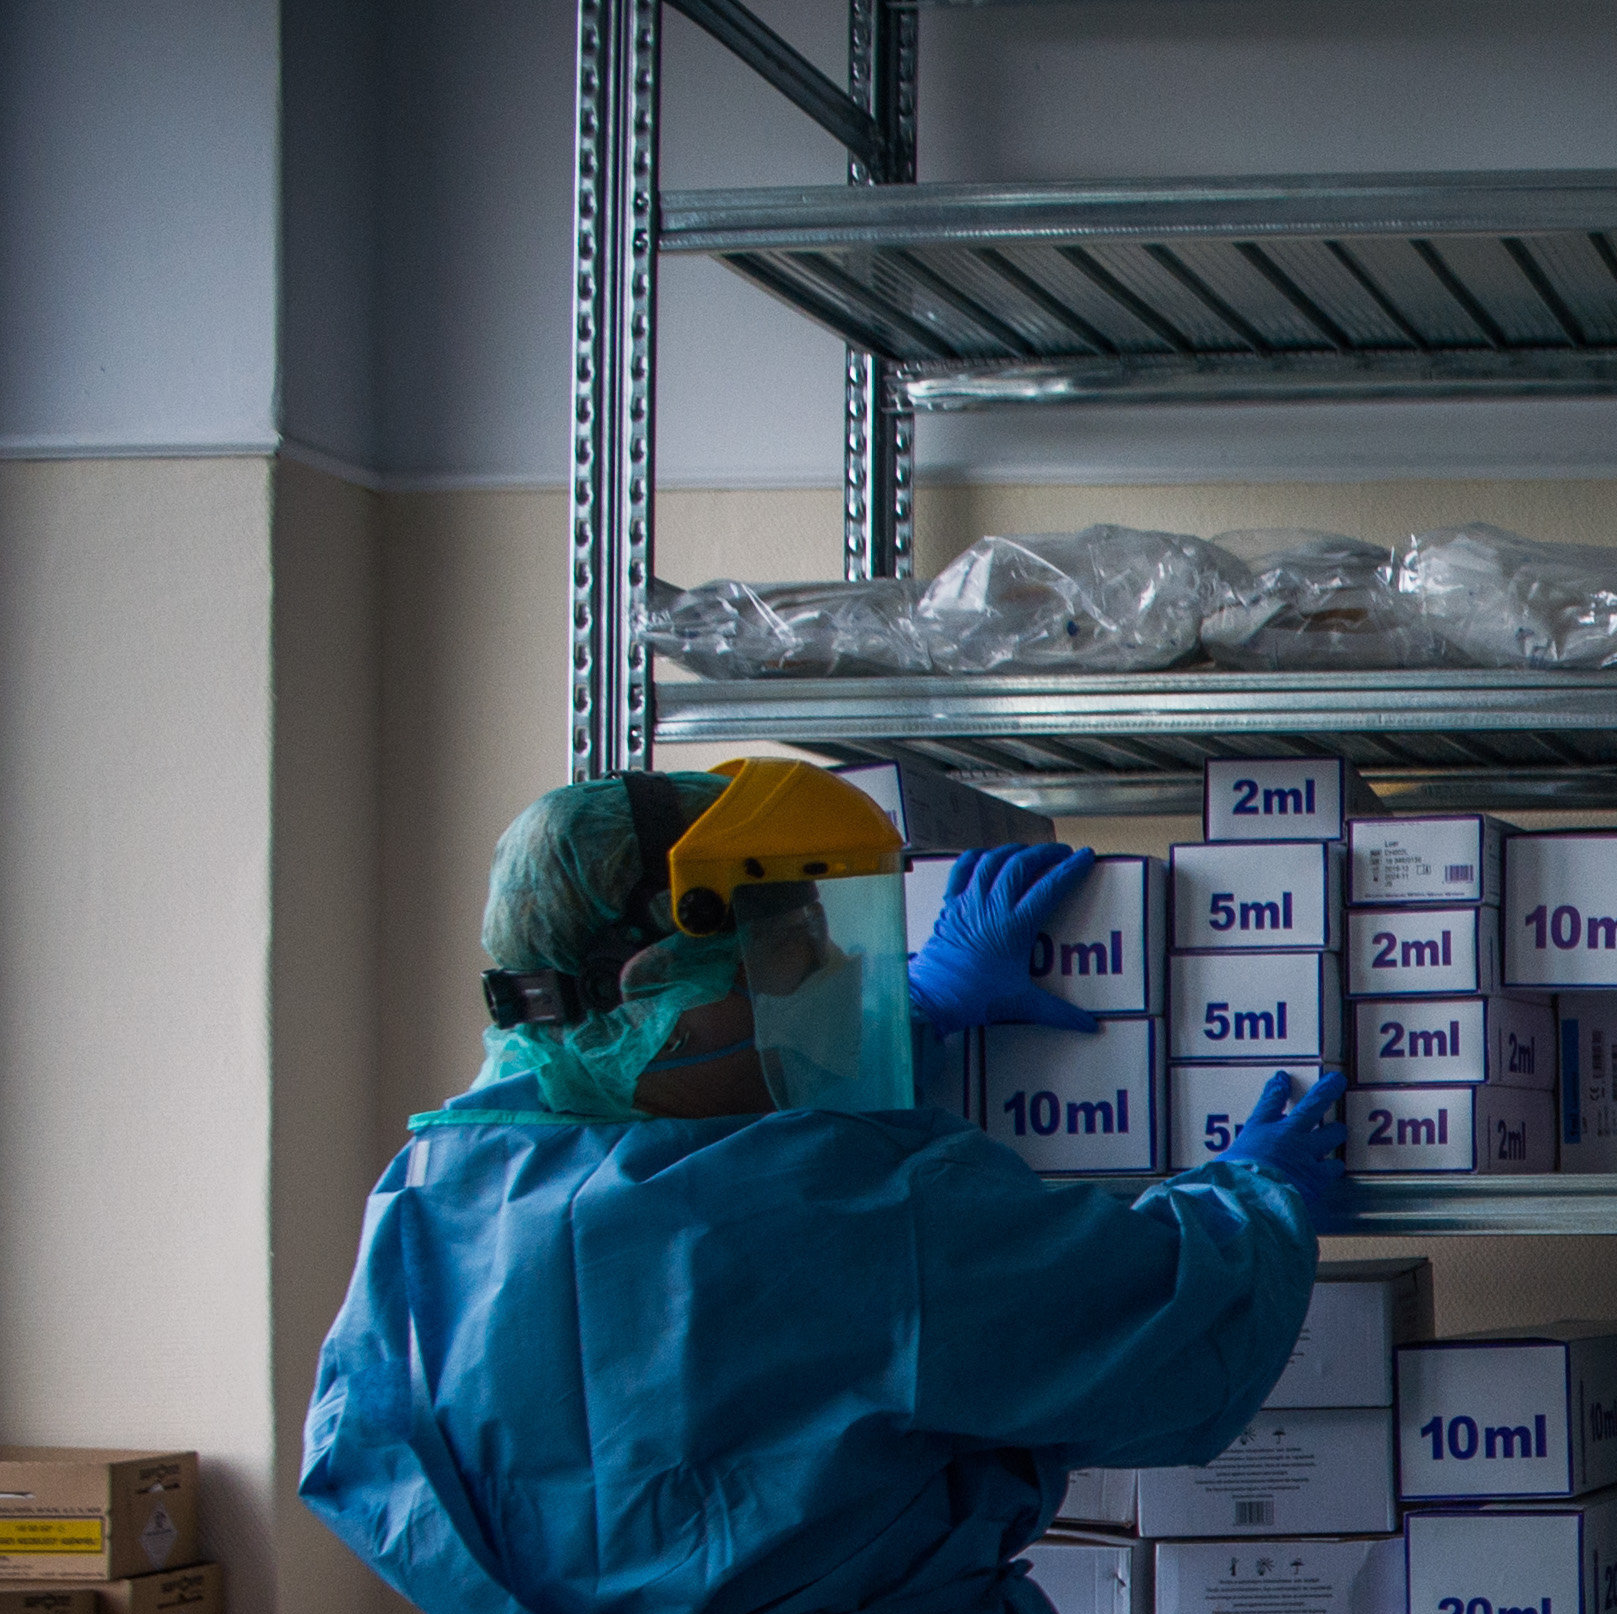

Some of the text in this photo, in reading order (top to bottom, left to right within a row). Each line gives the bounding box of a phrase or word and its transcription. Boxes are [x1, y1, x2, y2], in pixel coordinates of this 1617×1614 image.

[1233, 779, 1315, 815] 2ml
[1209, 892, 1292, 931] 5ml
[1372, 931, 1452, 969] 2ml
[1204, 1002, 1287, 1040] 5ml
[1380, 1021, 1459, 1058] 2ml
[1509, 1033, 1535, 1074] 2ml
[1003, 1090, 1129, 1136] 10ml
[1367, 1109, 1448, 1146] 2ml
[1498, 1121, 1527, 1160] 2ml
[1420, 1414, 1547, 1460] 10ml
